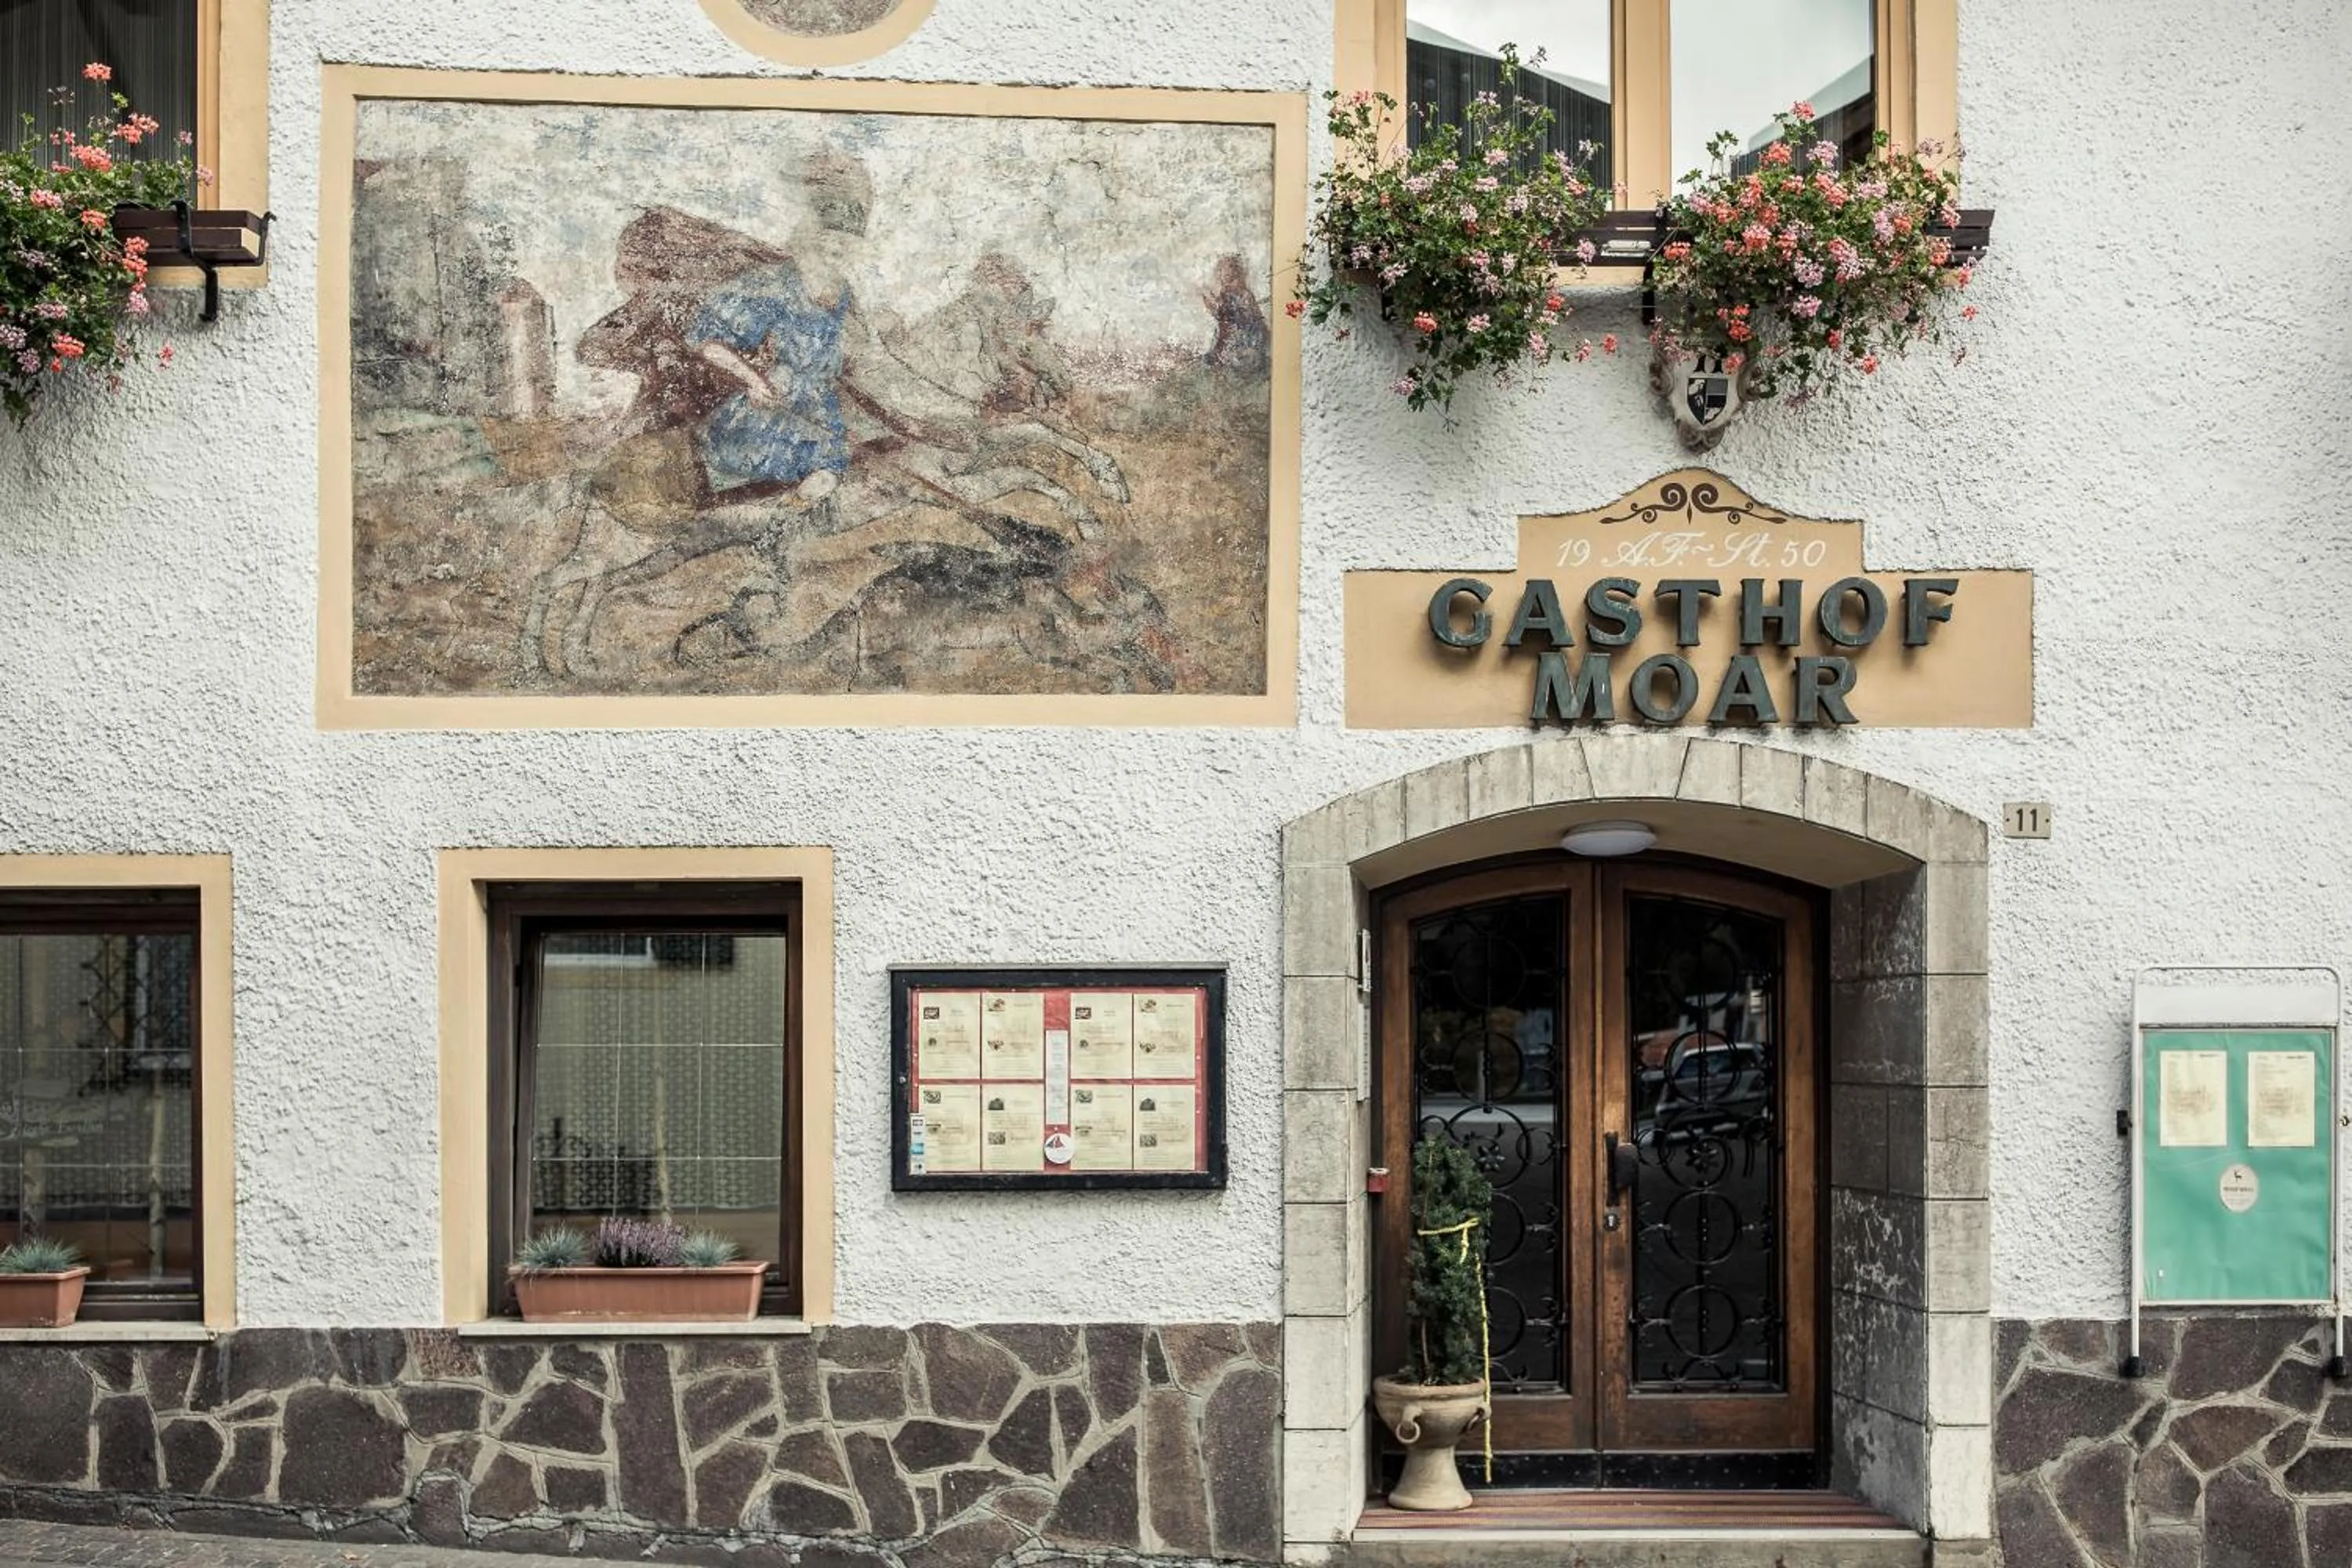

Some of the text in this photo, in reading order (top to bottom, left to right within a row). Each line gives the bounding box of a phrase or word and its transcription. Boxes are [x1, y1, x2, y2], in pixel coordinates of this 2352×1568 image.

[1556, 539, 1591, 568] 19
[1780, 539, 1827, 568] 50
[1427, 577, 1960, 648] GASTHOF
[1530, 652, 1860, 724] MOAR
[2016, 808, 2038, 832] 11
